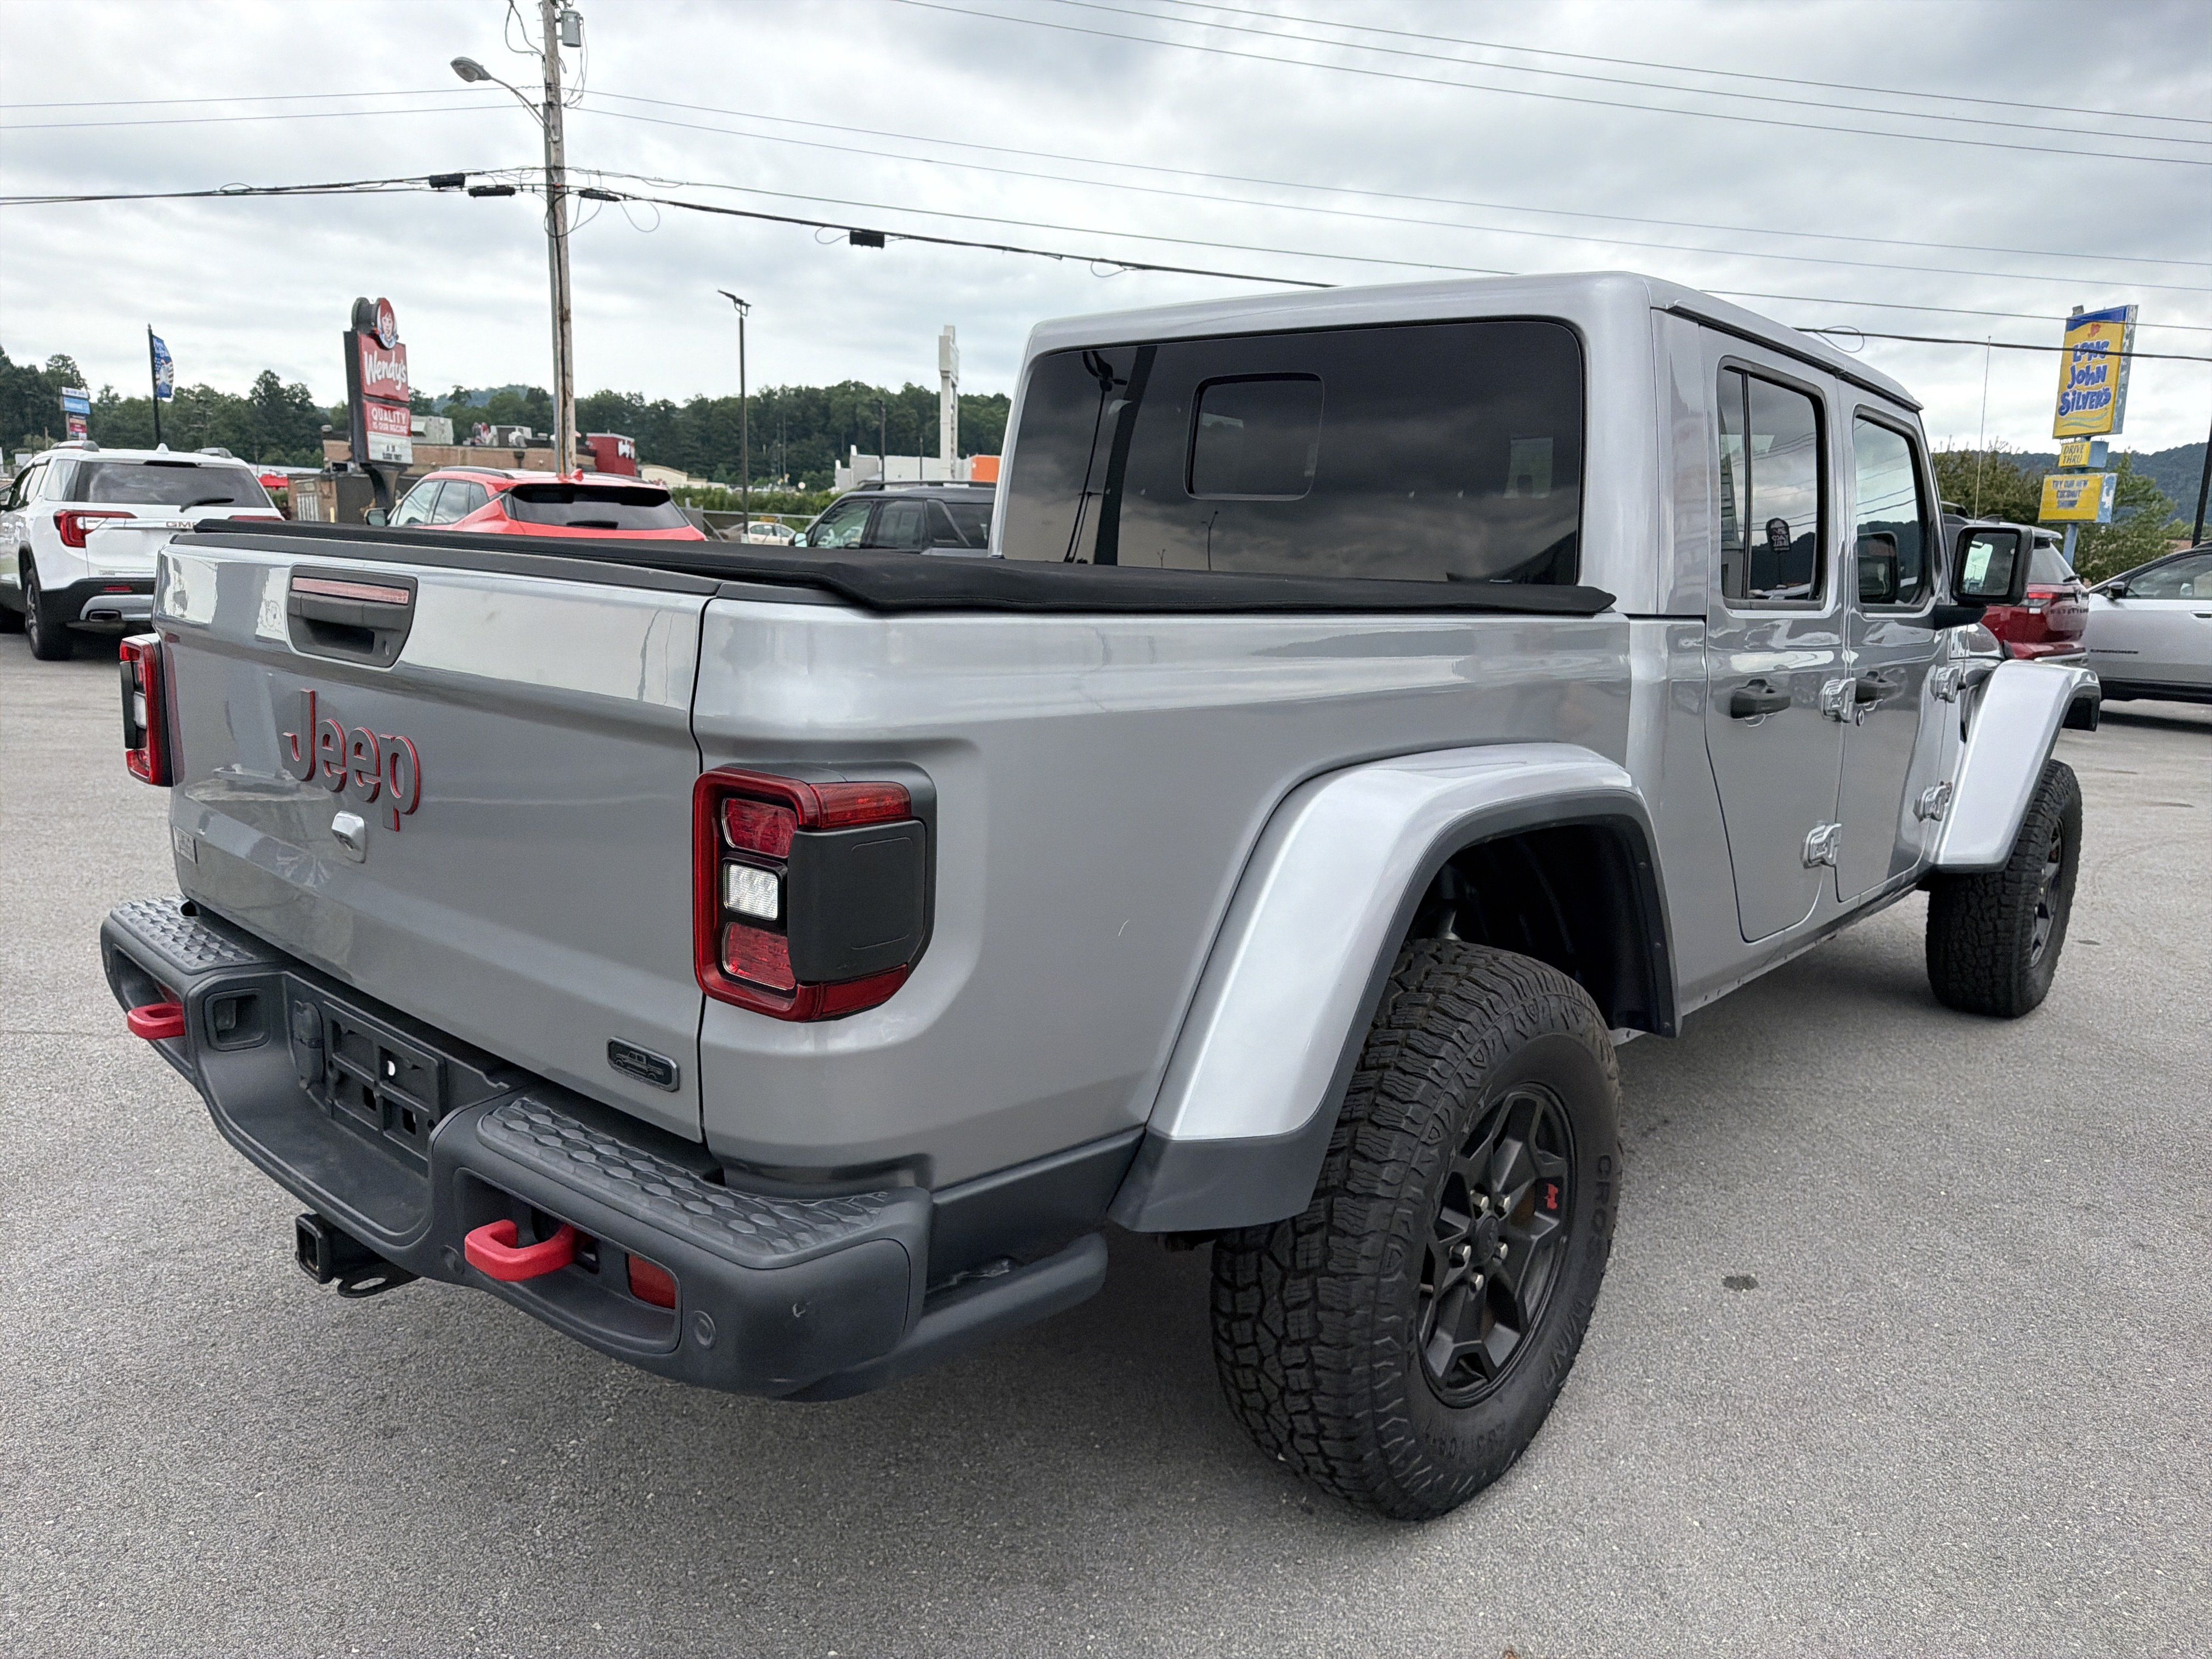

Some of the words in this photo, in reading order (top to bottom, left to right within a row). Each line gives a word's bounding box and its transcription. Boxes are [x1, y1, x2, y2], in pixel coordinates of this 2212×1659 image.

[2073, 341, 2109, 362] LONG
[364, 350, 407, 391] Wendy's
[371, 407, 406, 425] QUALITY
[2062, 454, 2083, 464] THRU
[2063, 444, 2085, 455] DRIVE
[280, 688, 421, 832] Jeep
